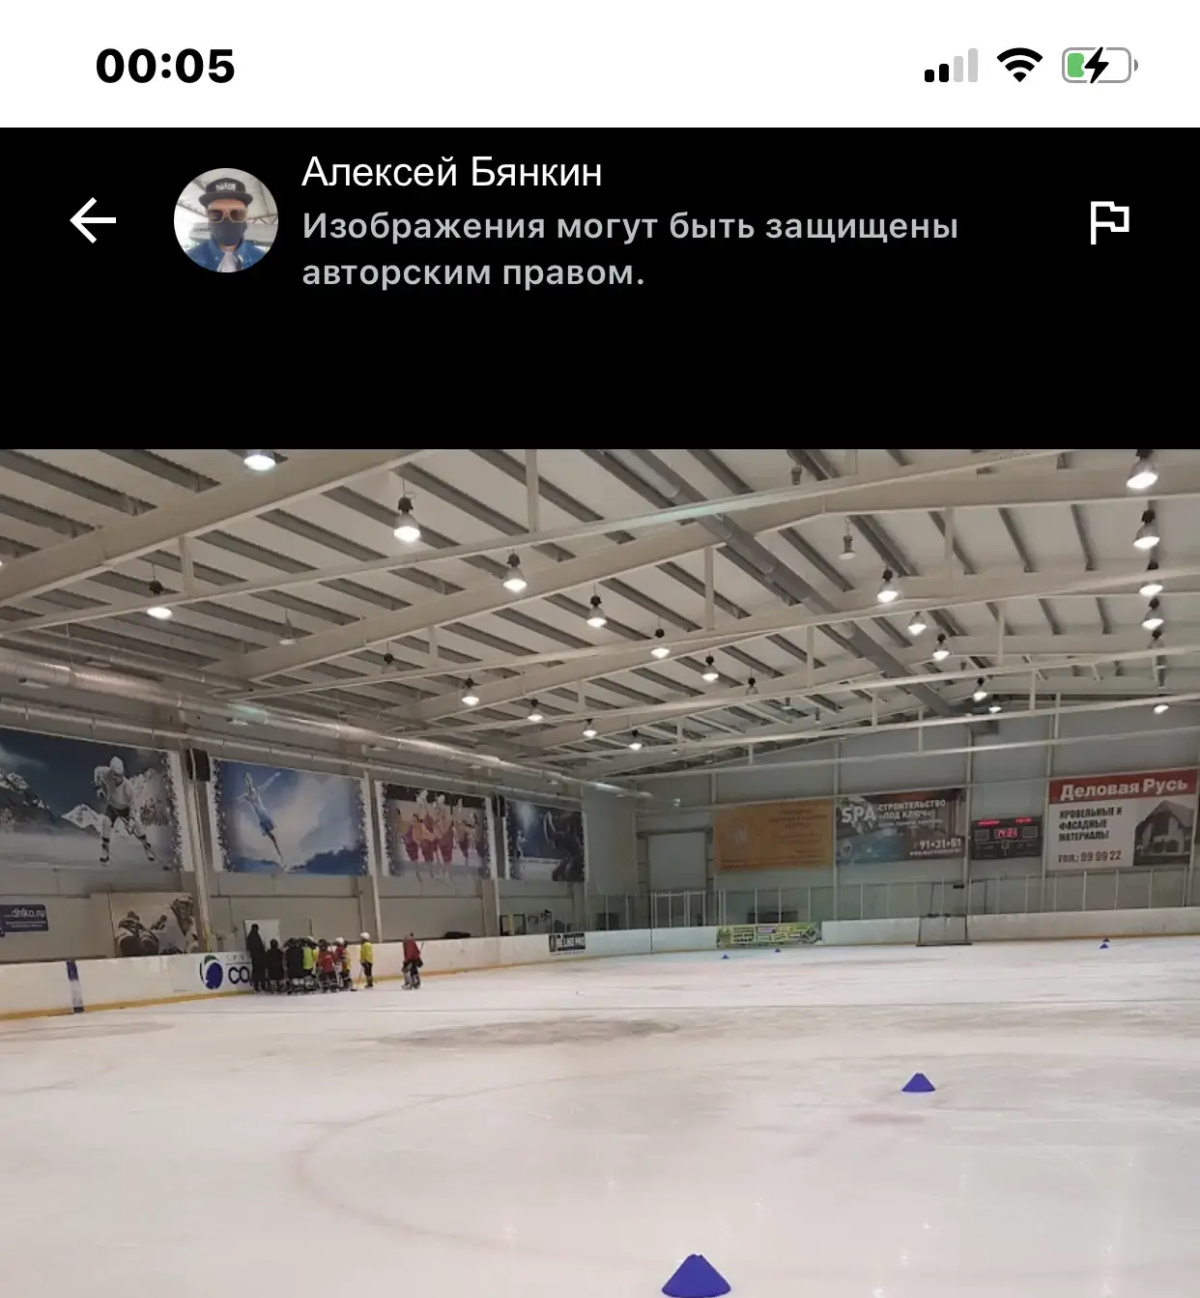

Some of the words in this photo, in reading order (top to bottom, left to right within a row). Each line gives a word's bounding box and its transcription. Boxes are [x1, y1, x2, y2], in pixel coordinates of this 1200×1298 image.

[1060, 781, 1140, 801] Деловая
[1142, 777, 1189, 797] Русь
[878, 799, 946, 811] СТРОИТЕЛЬСТВО
[841, 805, 876, 823] SPA
[1059, 807, 1115, 819] КРОВЕЛЬНЫЕ
[1116, 807, 1123, 816] И
[1059, 819, 1107, 830] ФАСАДНЫЕ
[1059, 831, 1110, 841] МАТЕРИАЛЫ
[1109, 850, 1122, 860] 22
